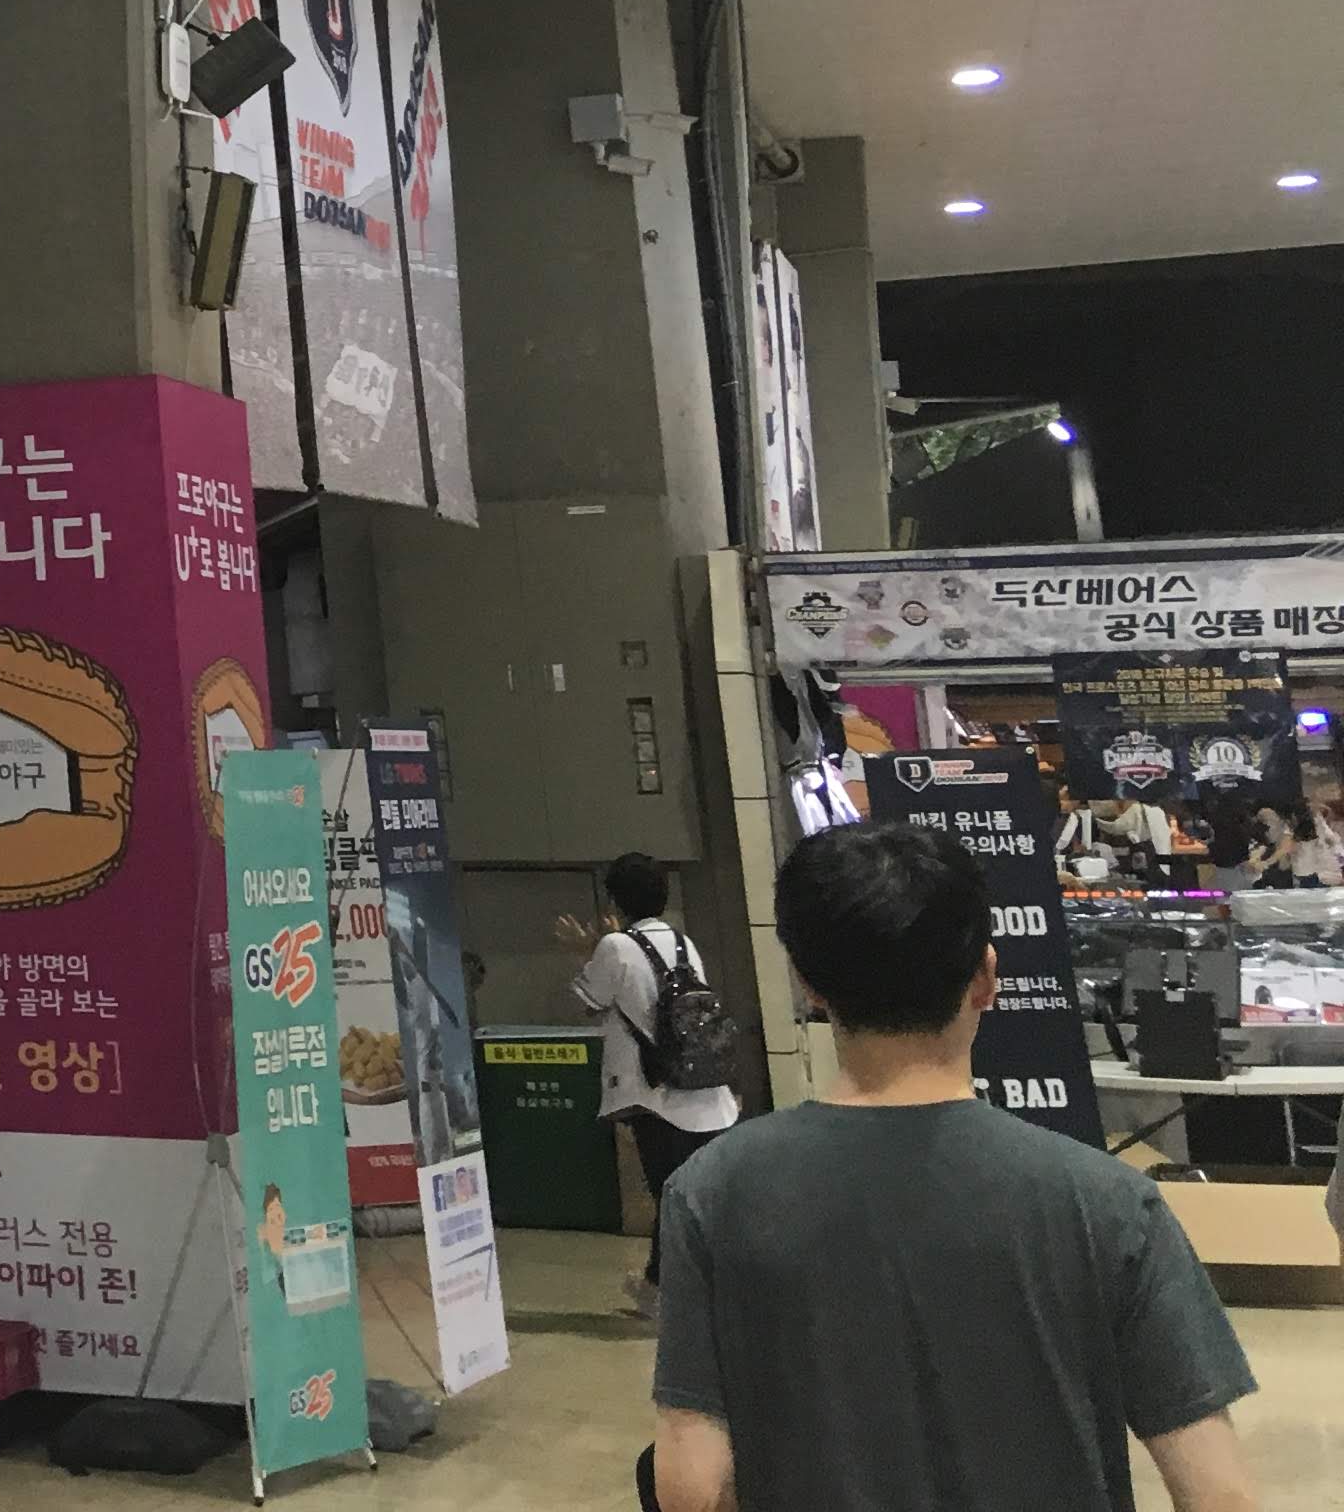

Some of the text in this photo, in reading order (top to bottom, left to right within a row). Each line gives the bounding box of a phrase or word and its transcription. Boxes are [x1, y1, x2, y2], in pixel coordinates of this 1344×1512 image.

[299, 155, 345, 198] TEAM
[176, 472, 244, 534] 프로야구는
[216, 539, 256, 593] 봅니다
[991, 575, 1198, 608] 두산베어스
[1103, 612, 1175, 642] 공식
[1191, 608, 1265, 638] 상품
[954, 810, 1012, 832] 유니폼
[243, 867, 314, 908] 어서오세요
[18, 954, 89, 983] 방면의
[245, 921, 322, 1007] GS25
[16, 988, 64, 1017] 골라
[71, 989, 119, 1019] 보는
[266, 1083, 320, 1134] 입니다
[1001, 1077, 1068, 1109] BAD
[59, 1219, 118, 1259] 전용
[97, 1267, 138, 1305] 존!
[54, 1329, 142, 1359] 즐기세요
[288, 1368, 336, 1422] GS25
